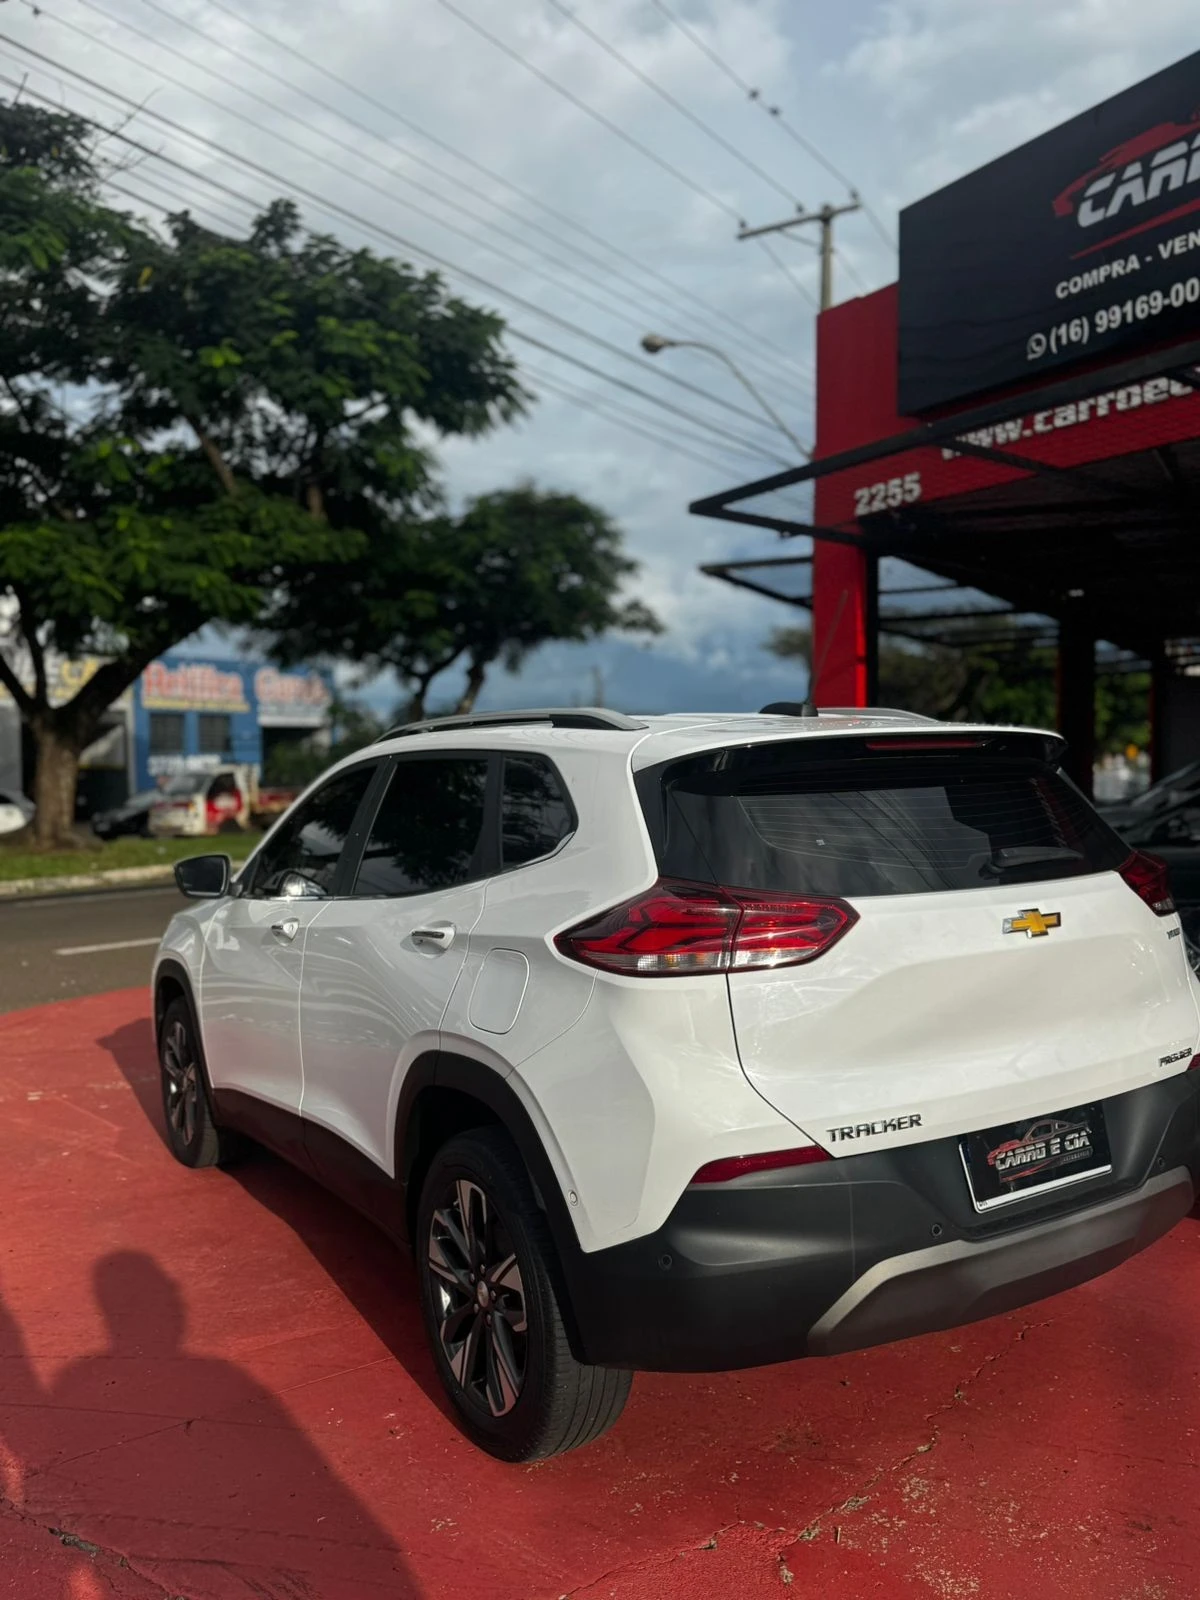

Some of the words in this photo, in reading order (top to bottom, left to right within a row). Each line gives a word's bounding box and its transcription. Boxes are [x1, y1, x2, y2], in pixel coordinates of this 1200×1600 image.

[1055, 253, 1140, 299] COMPRA
[1049, 315, 1090, 355] (16)
[854, 471, 922, 517] 2255
[826, 1113, 923, 1142] TRACKER
[996, 1141, 1047, 1171] CARRO
[1050, 1137, 1061, 1156] E
[1064, 1126, 1093, 1150] CIA
